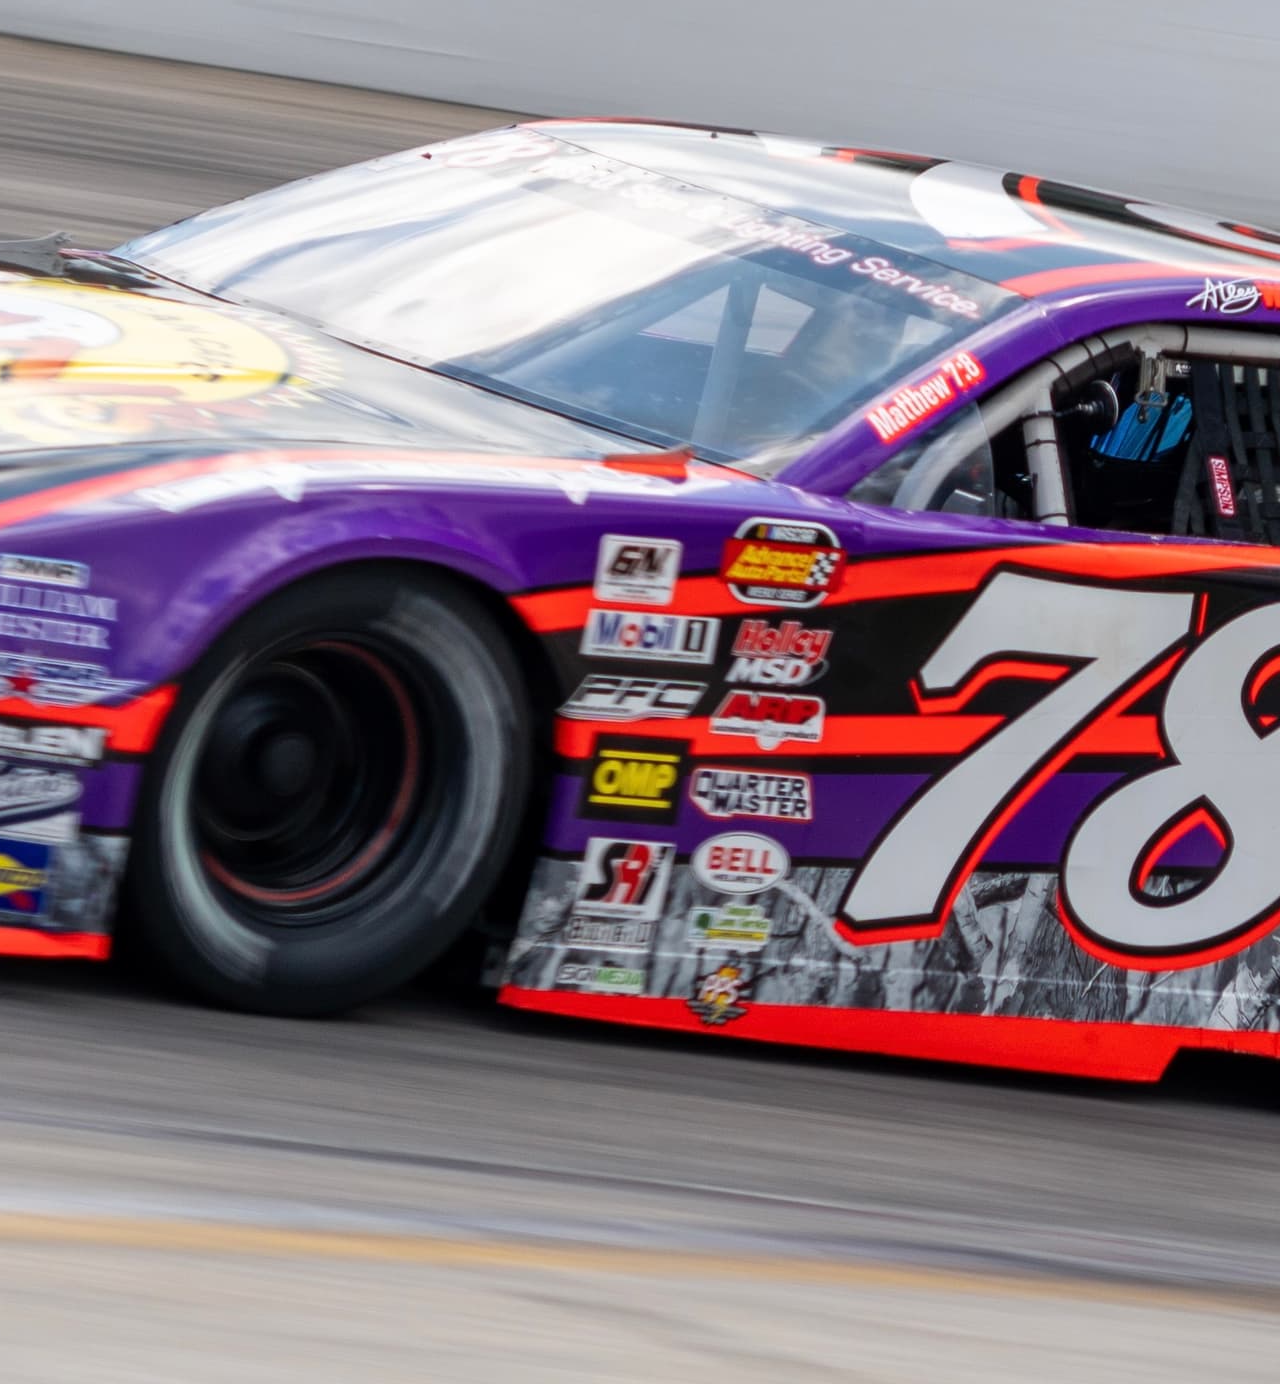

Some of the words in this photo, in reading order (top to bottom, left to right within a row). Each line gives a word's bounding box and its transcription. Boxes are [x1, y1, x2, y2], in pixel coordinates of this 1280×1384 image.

[868, 374, 952, 440] Matthew
[941, 351, 981, 388] 7:8
[1210, 458, 1235, 516] SIMPSON
[597, 611, 678, 649] Mobil
[725, 657, 814, 687] MSD
[593, 759, 677, 798] OMP
[695, 769, 806, 800] QUARTER
[714, 791, 808, 818] MASTER
[708, 845, 778, 875] BELL
